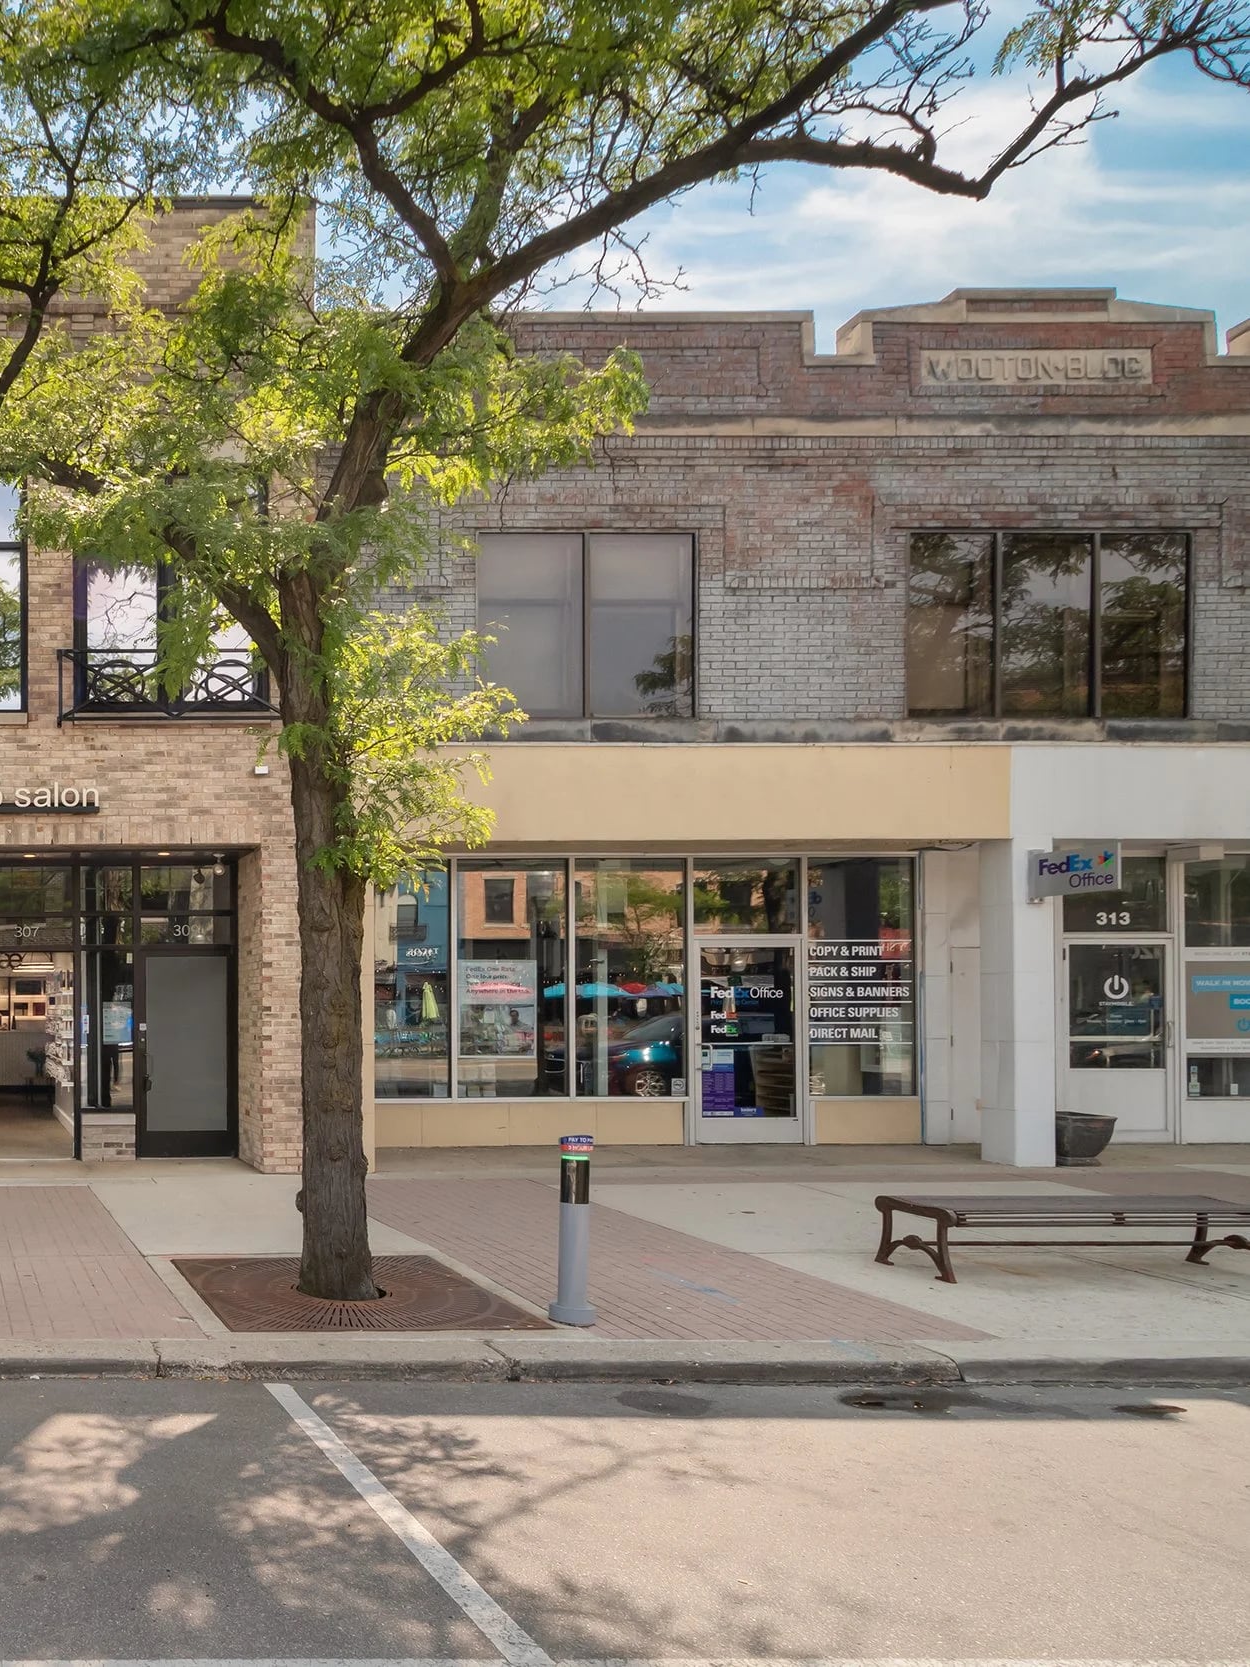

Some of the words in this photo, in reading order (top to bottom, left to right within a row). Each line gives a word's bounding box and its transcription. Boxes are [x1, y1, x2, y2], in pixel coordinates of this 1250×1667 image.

[14, 782, 100, 808] salon
[1039, 854, 1093, 876] FedEx
[1069, 873, 1114, 888] Office
[1096, 911, 1131, 926] 313
[13, 926, 39, 938] 307
[809, 945, 838, 956] COPY
[840, 945, 850, 956] &
[851, 945, 883, 956] PRINT
[810, 966, 838, 977] PACK
[840, 966, 849, 977] &
[851, 966, 877, 977] SHIP
[711, 986, 750, 999] FedEx
[750, 986, 784, 999] Office
[810, 986, 844, 997] SIGNS
[845, 986, 855, 997] &
[856, 986, 910, 997] BANNERS
[810, 1007, 846, 1018] OFFICE
[847, 1007, 899, 1018] SUPPLIES
[711, 1025, 738, 1034] FedEx
[810, 1028, 848, 1039] DIRECT
[850, 1028, 878, 1039] MAIL
